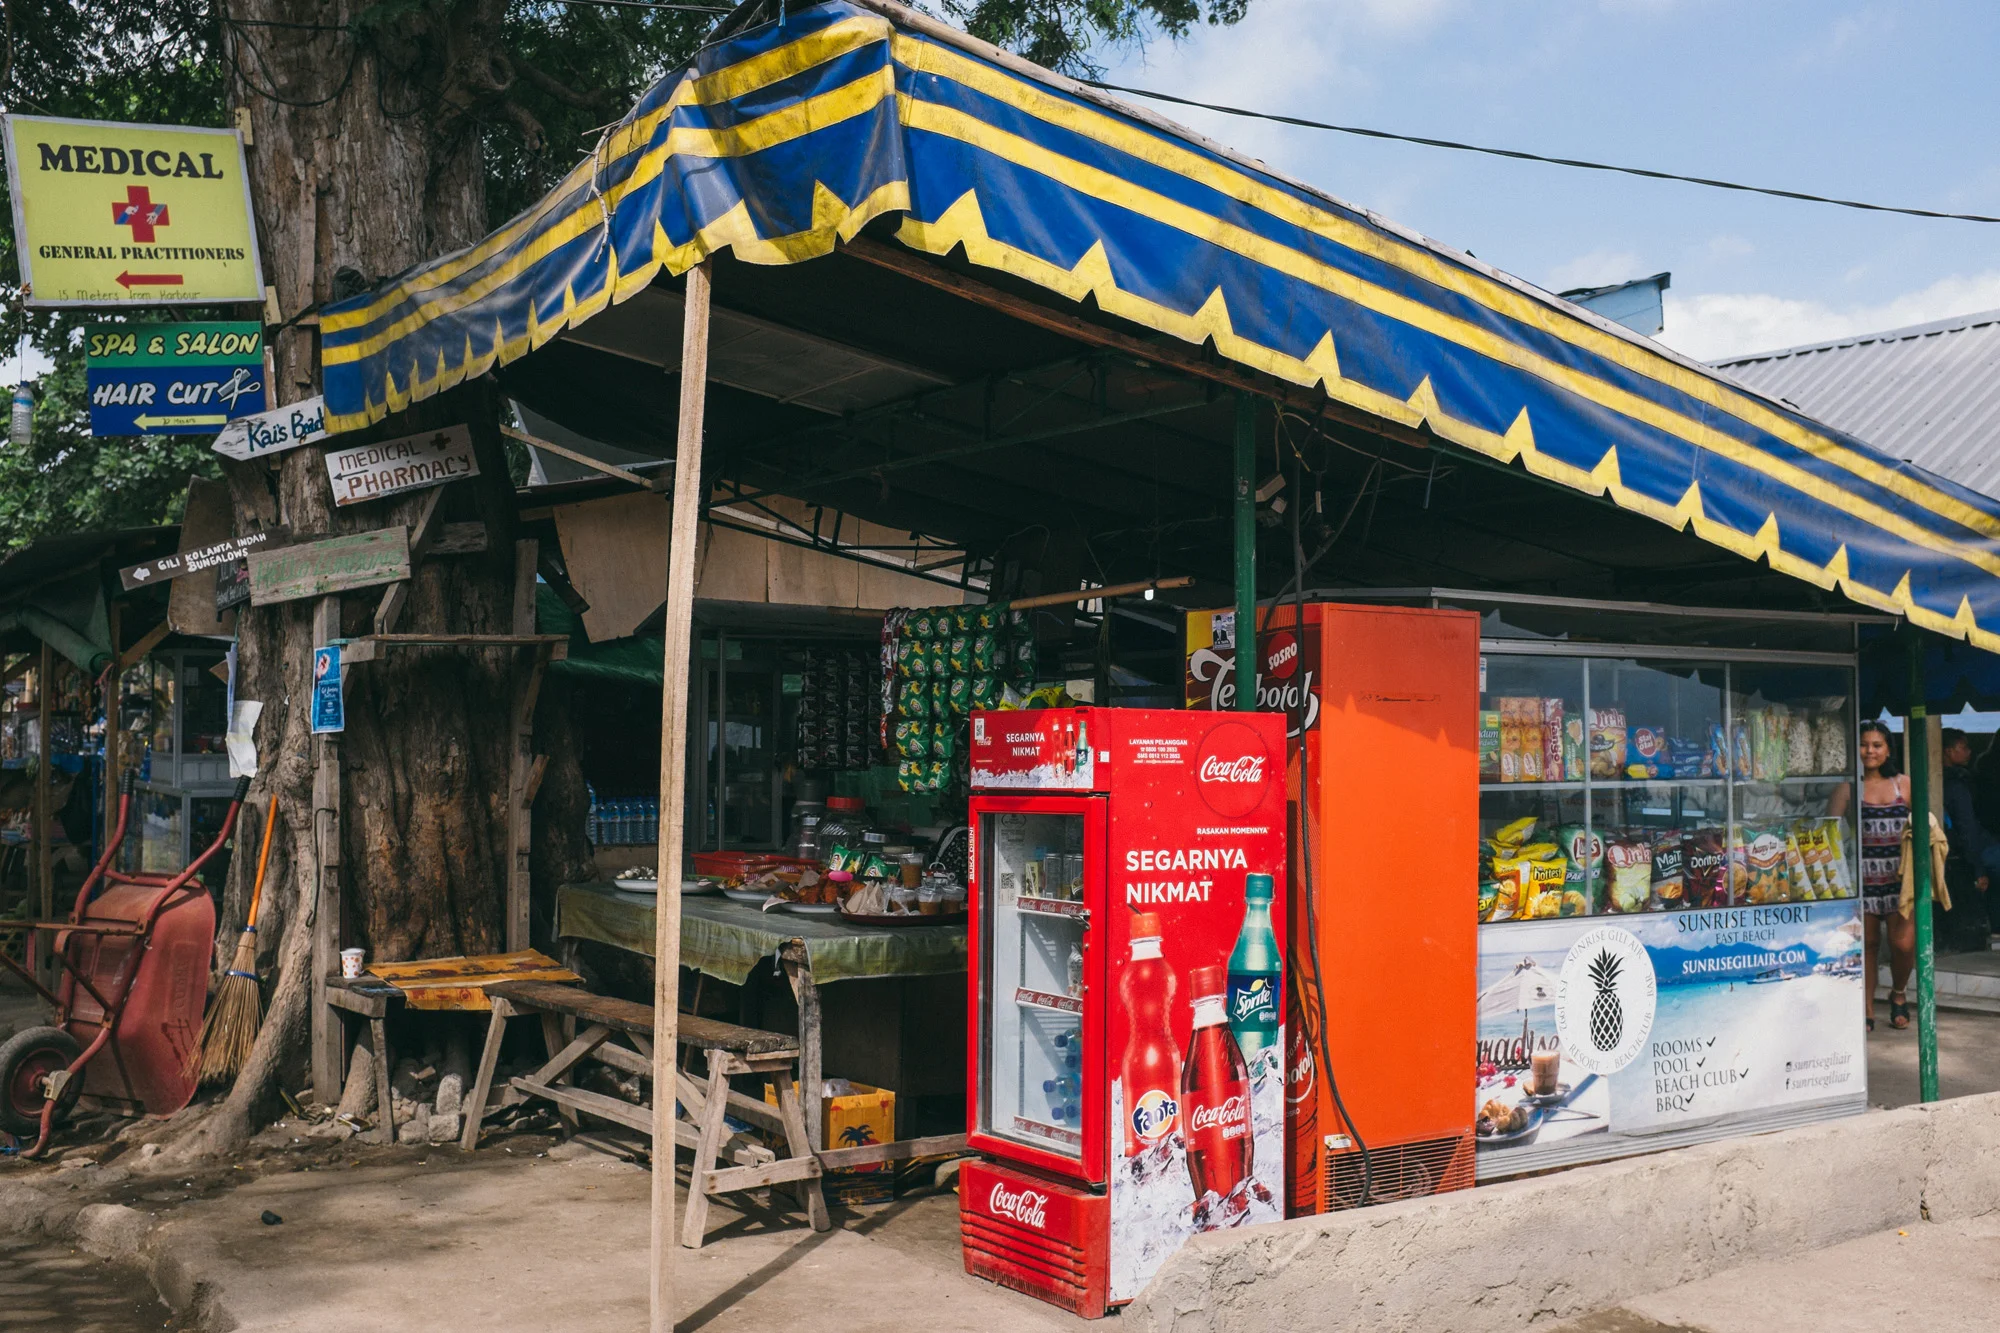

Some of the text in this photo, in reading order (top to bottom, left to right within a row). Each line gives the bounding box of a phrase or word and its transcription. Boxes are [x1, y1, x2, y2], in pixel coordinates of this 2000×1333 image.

[36, 142, 224, 180] MEDICAL
[39, 244, 245, 261] GENERAL PRACTITIONERS
[58, 289, 69, 301] 15
[77, 289, 120, 301] Meters
[128, 289, 152, 302] from
[89, 332, 260, 357] SPA & SALON
[92, 381, 220, 407] HAIR CUT
[339, 443, 422, 472] MEDICAL
[347, 453, 472, 498] PHARMACY
[157, 533, 267, 571] GILI KOLANTA INDAH
[1268, 641, 1298, 671] SOSRO
[1006, 732, 1046, 743] SEGARNYA
[1550, 716, 1563, 764] Tango
[1012, 746, 1041, 757] NIKMAT
[1200, 755, 1266, 783] Coca-Cola
[1196, 826, 1269, 835] RASAKAN MOMENNYA
[1125, 848, 1248, 872] SEGARNYA
[1690, 854, 1722, 868] Doritos
[1533, 866, 1562, 881] hottest
[1126, 881, 1213, 904] NIKMAT
[1678, 905, 1812, 933] SUNRISE RESORT
[1567, 929, 1645, 964] SUNRISE GILI AIR
[1715, 928, 1775, 945] EAST BEACH
[1682, 949, 1807, 975] SUNRISEGILIAIR.COM
[1645, 972, 1655, 997] BAR
[1236, 986, 1271, 1016] Sprite
[1568, 1043, 1601, 1072] RESORT
[1652, 1037, 1703, 1058] ROOMS
[1653, 1057, 1691, 1076] POOL
[1792, 1052, 1852, 1072] sunrisegiliair
[1655, 1068, 1737, 1095] BEACH CLUB
[1791, 1071, 1851, 1090] sunrisegiliair
[1191, 1095, 1246, 1132] Coca-Cola
[1656, 1094, 1688, 1113] BBQ
[1132, 1099, 1178, 1136] Fanta
[989, 1182, 1049, 1229] Coca-Cola
